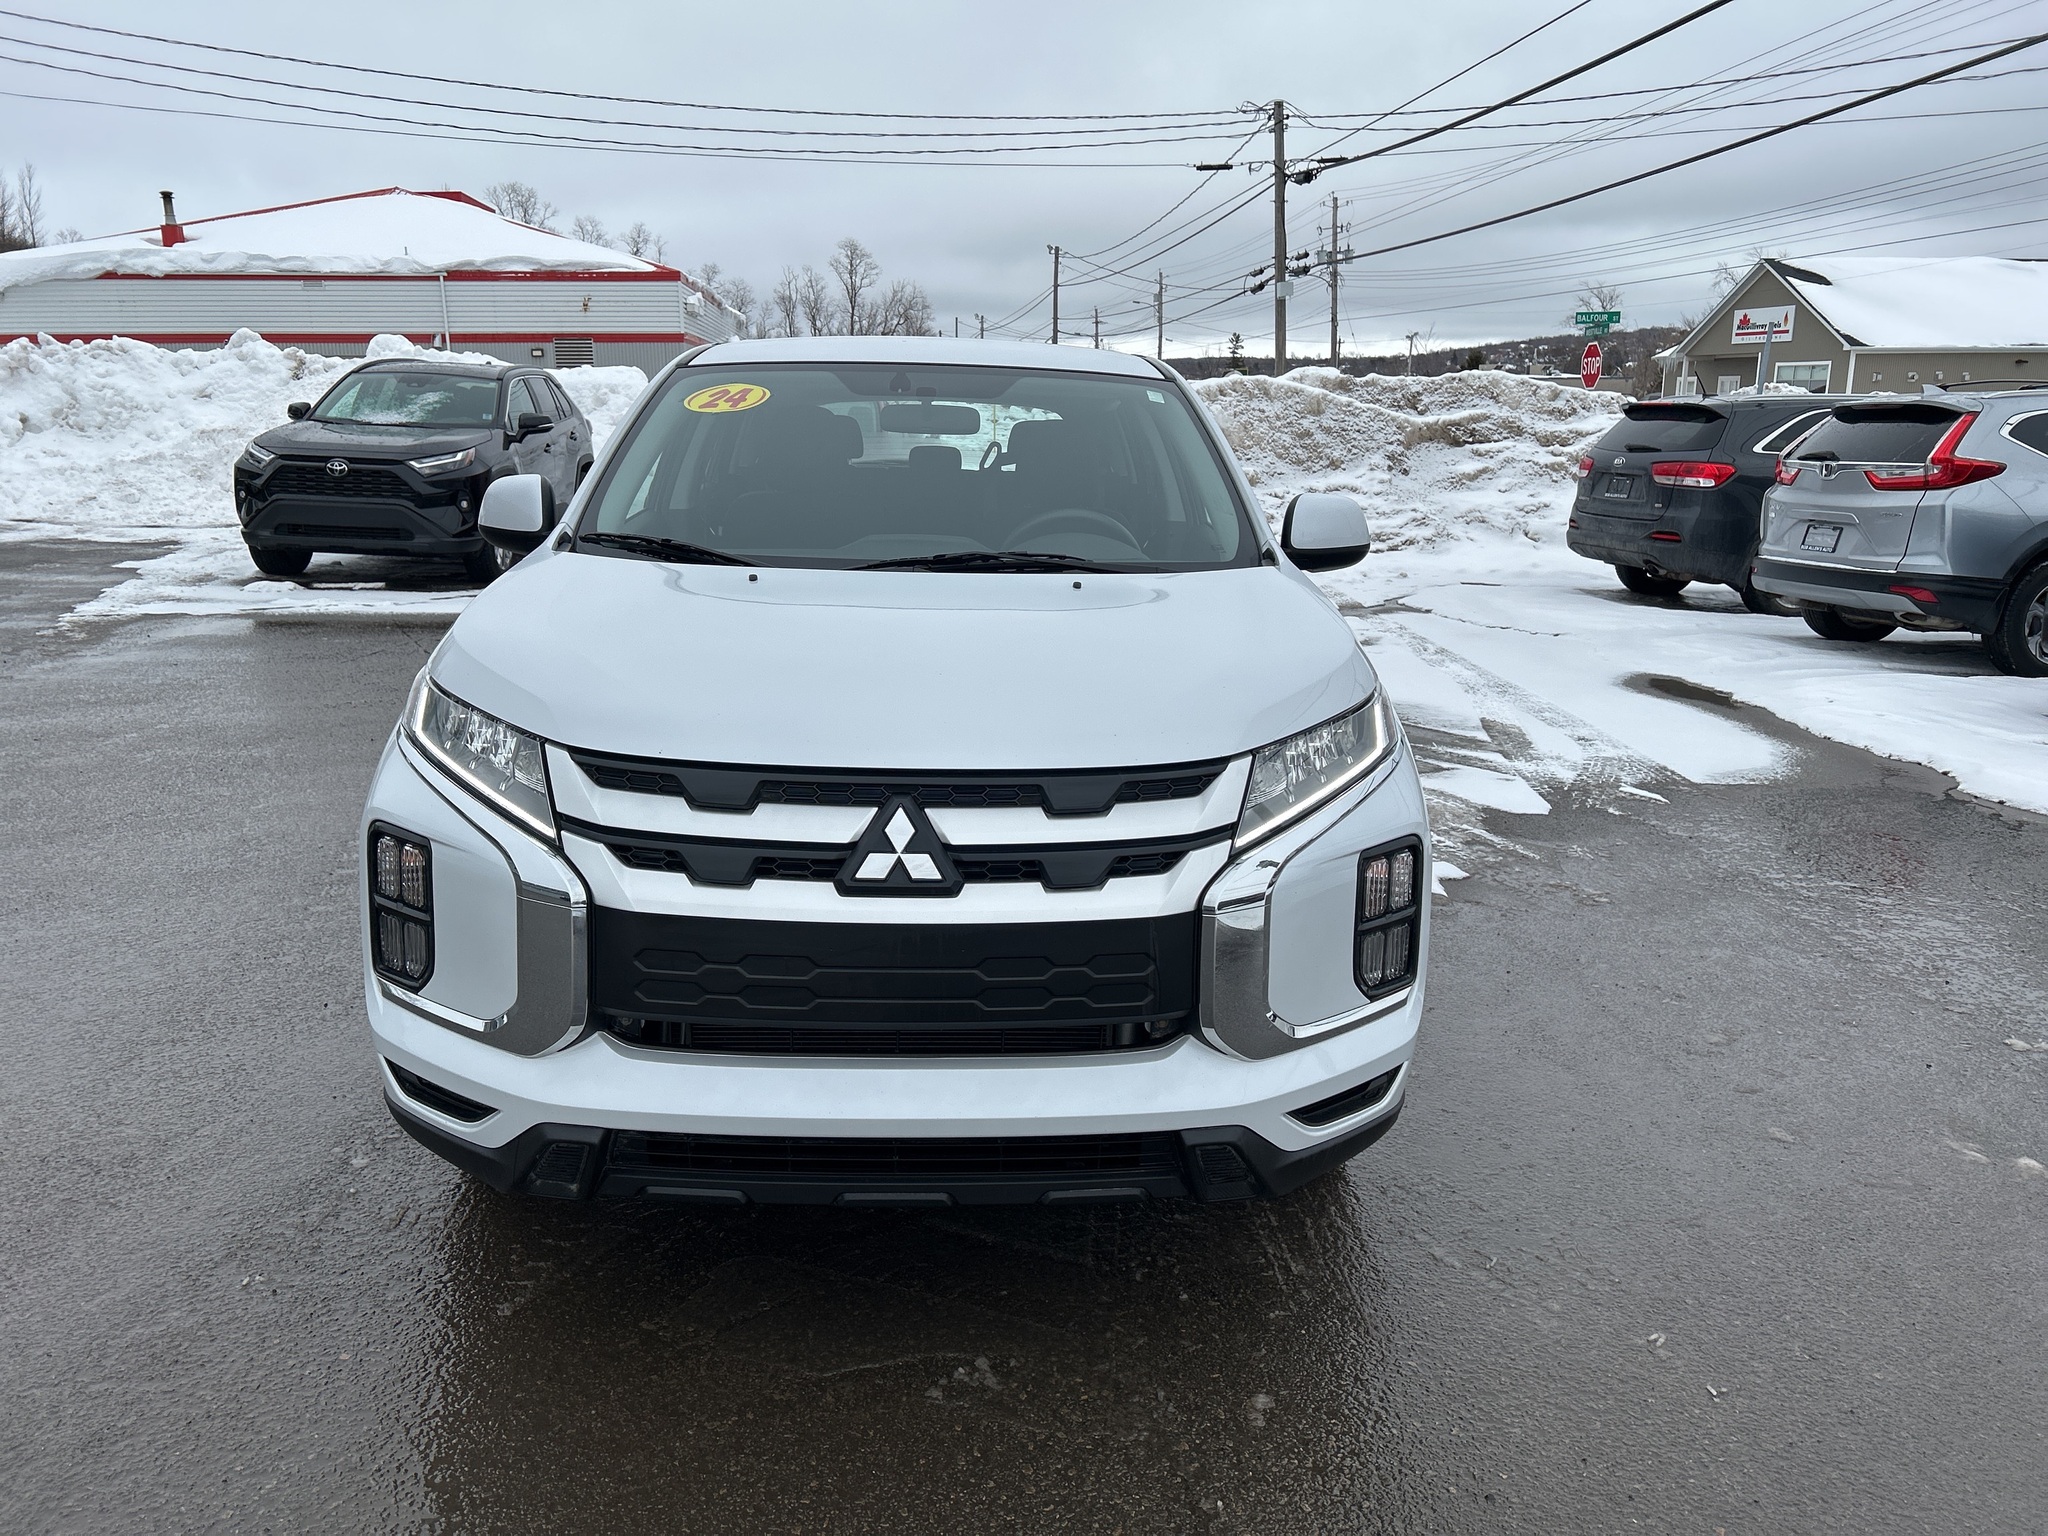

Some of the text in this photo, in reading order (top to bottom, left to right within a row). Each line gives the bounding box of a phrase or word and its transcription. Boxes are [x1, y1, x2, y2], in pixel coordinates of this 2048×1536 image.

[1577, 314, 1608, 322] BALFOUR
[1583, 357, 1601, 375] STOP
[698, 388, 754, 409] 24
